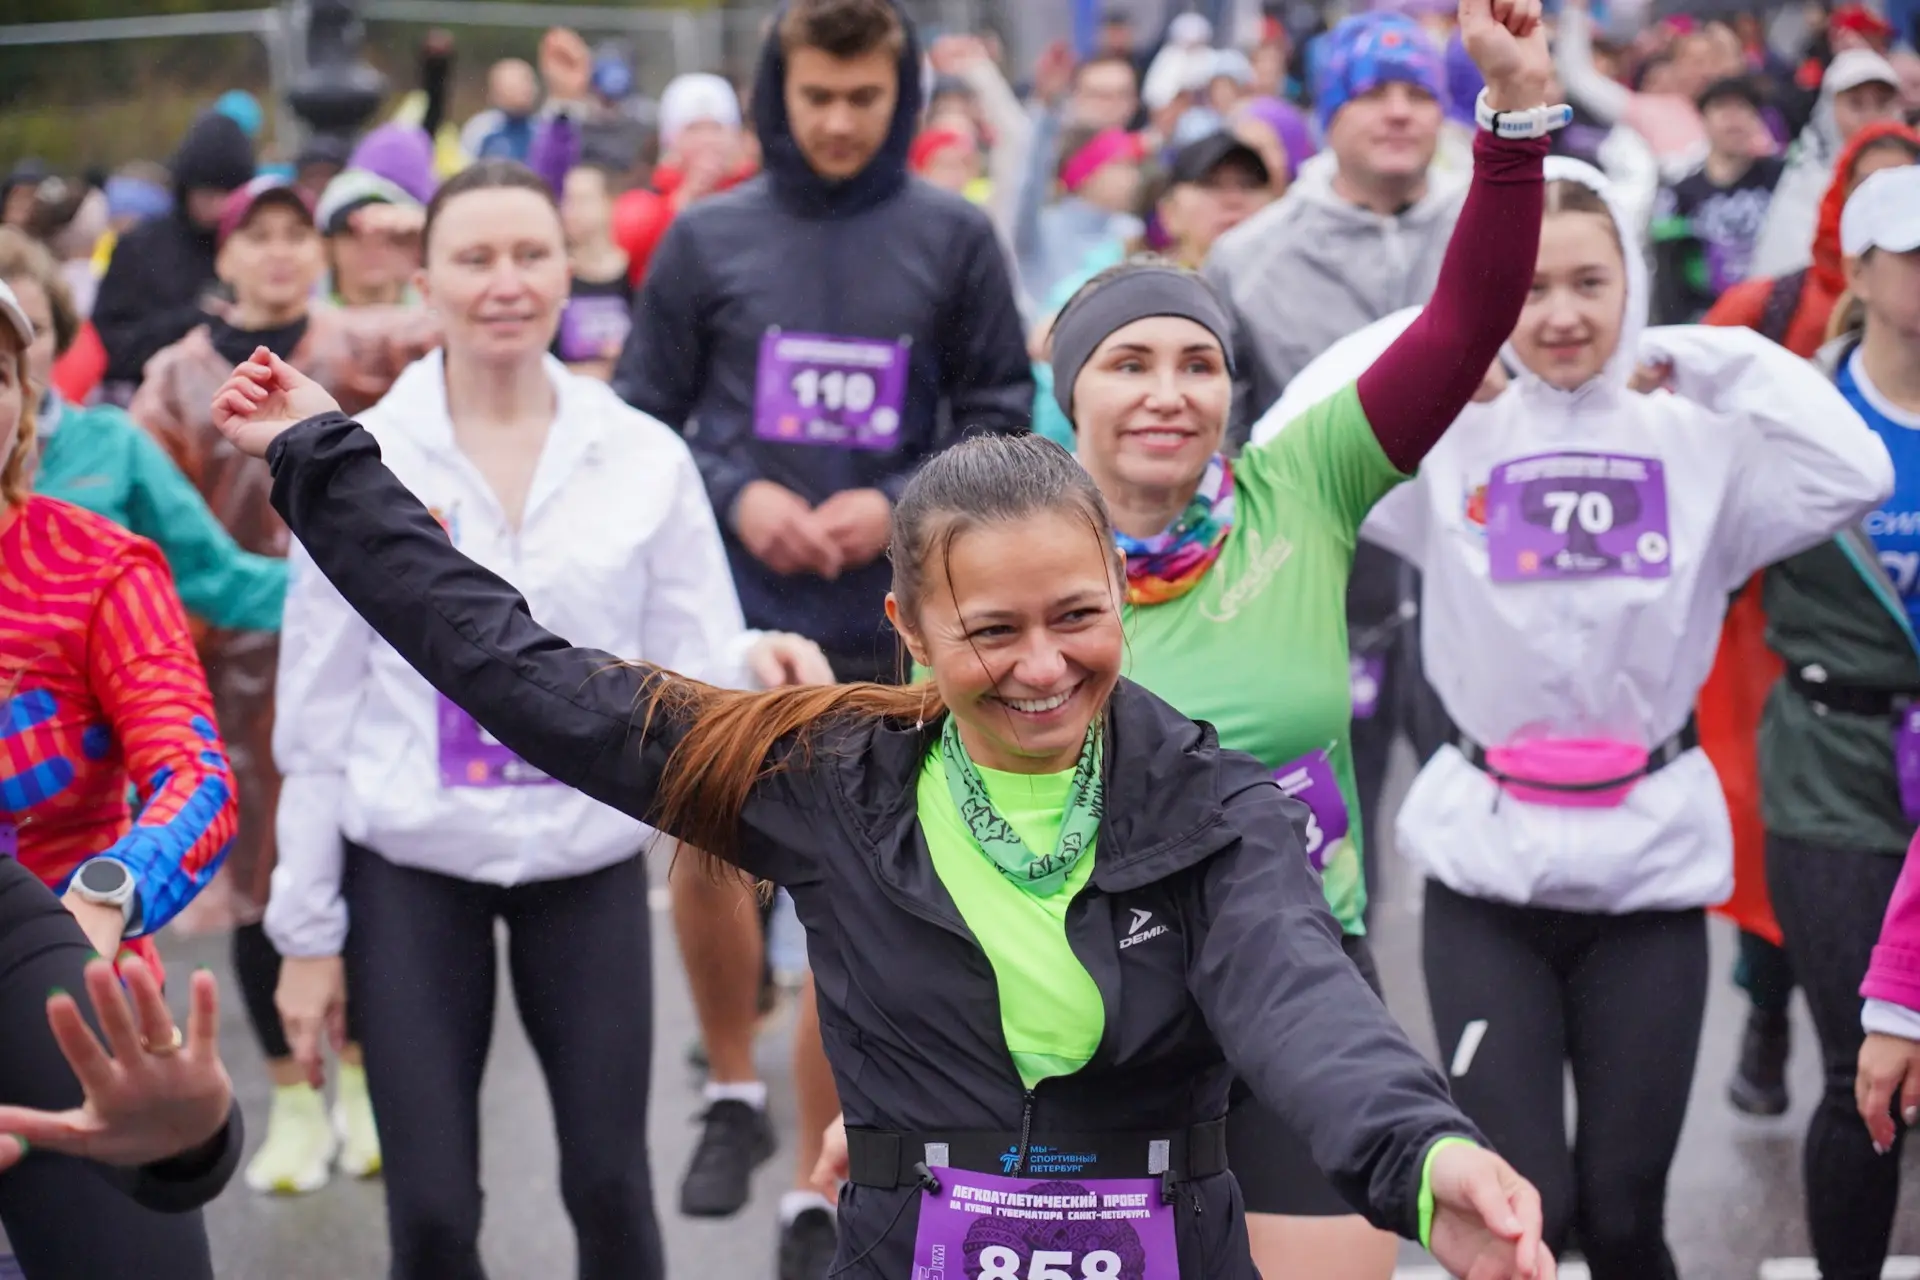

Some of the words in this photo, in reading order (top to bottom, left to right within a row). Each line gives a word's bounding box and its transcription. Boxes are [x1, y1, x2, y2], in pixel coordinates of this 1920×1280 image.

[791, 368, 876, 413] 110
[1542, 491, 1614, 534] 70
[1119, 924, 1169, 949] DEMIX
[1030, 1153, 1097, 1163] СПОРТИВНЫЙ
[1030, 1164, 1083, 1173] ПЕТЕРБУРГ
[952, 1184, 1098, 1209] ЛЕГКОАТЛЕТИЧЕСКИЙ
[1103, 1193, 1148, 1207] ПРОБЕГ
[950, 1200, 961, 1210] НА
[965, 1202, 992, 1215] КУБОК
[996, 1207, 1064, 1220] ГУБЕРНАТОРА
[1067, 1209, 1151, 1220] САНКТ-ПЕТЕРБУРГА
[976, 1245, 1123, 1280] 858
